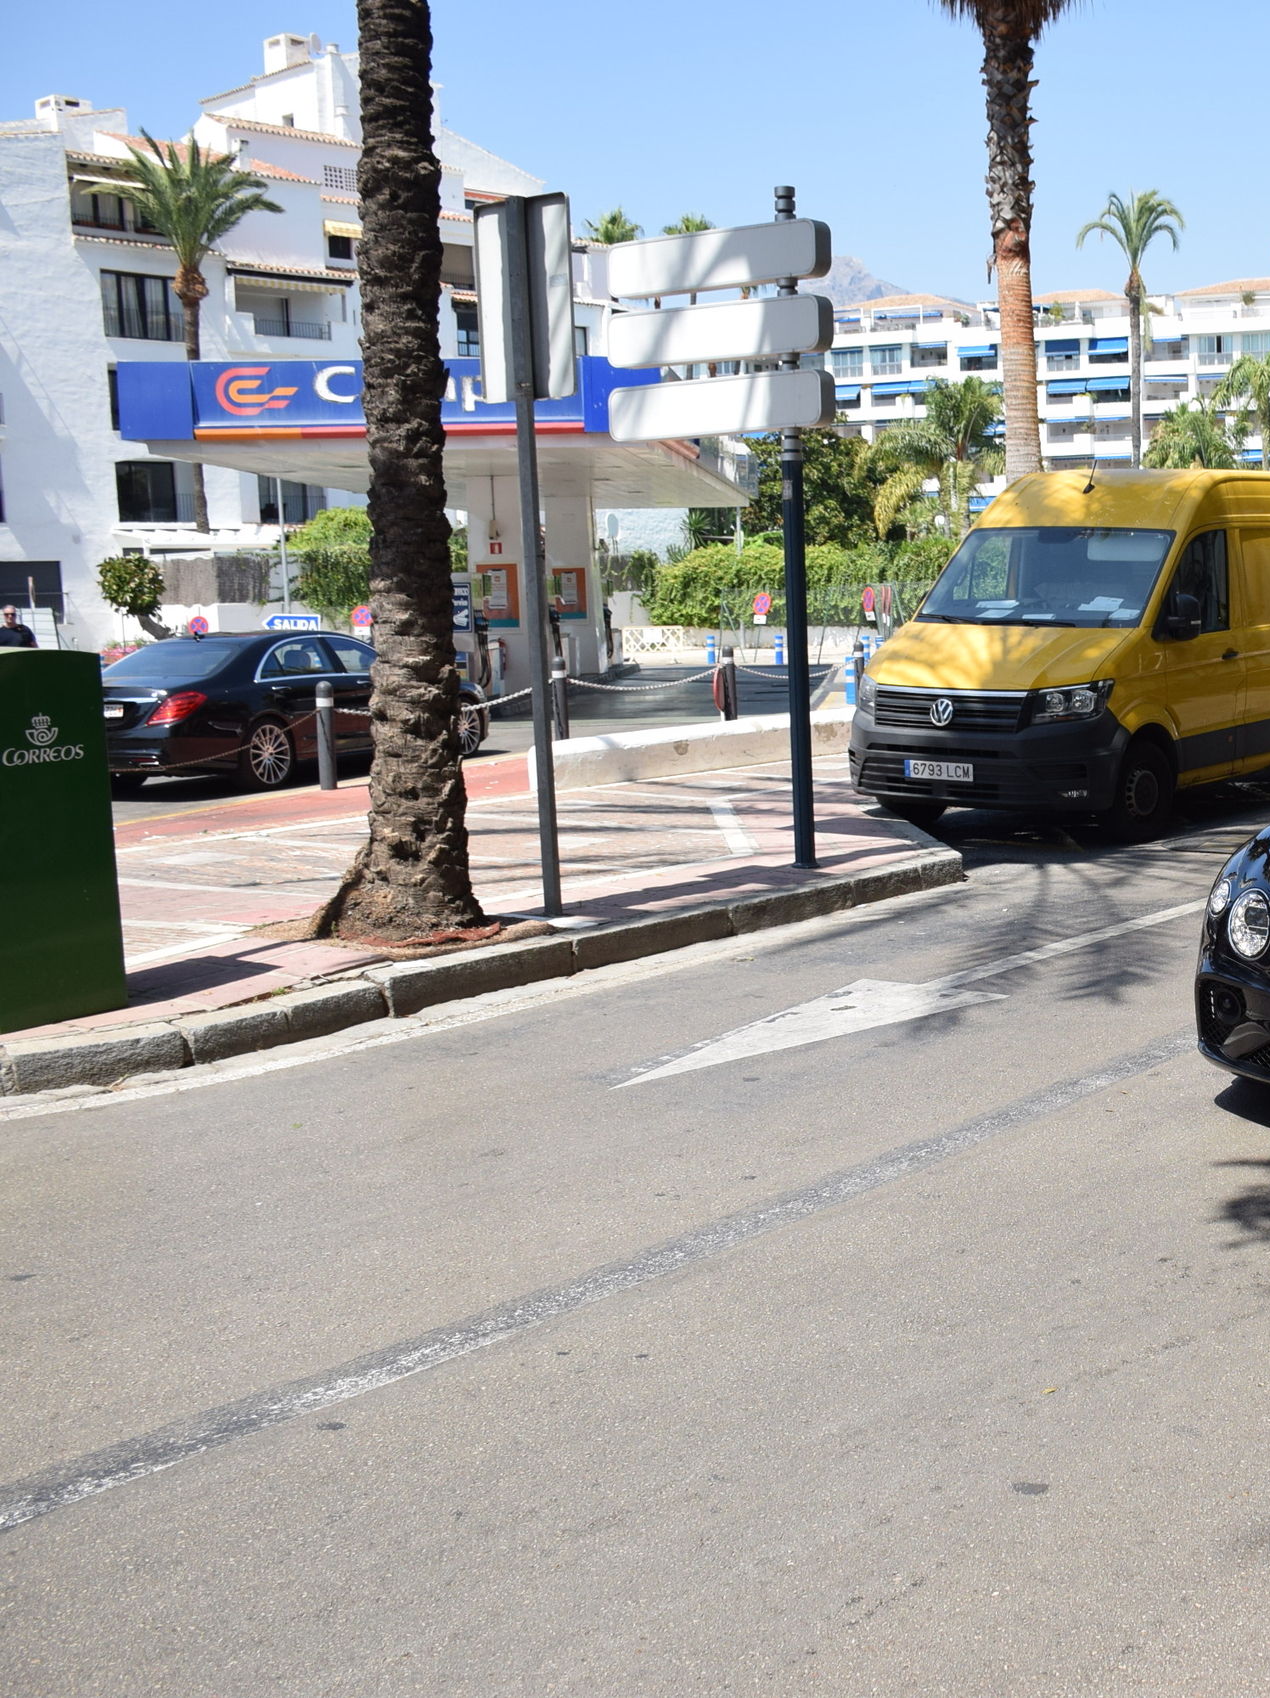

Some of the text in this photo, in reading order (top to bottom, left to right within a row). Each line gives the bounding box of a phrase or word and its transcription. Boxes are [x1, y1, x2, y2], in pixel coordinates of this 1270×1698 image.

[271, 618, 318, 631] SALIDA
[2, 744, 84, 767] CORREOS
[912, 762, 970, 779] 6793 LCM
